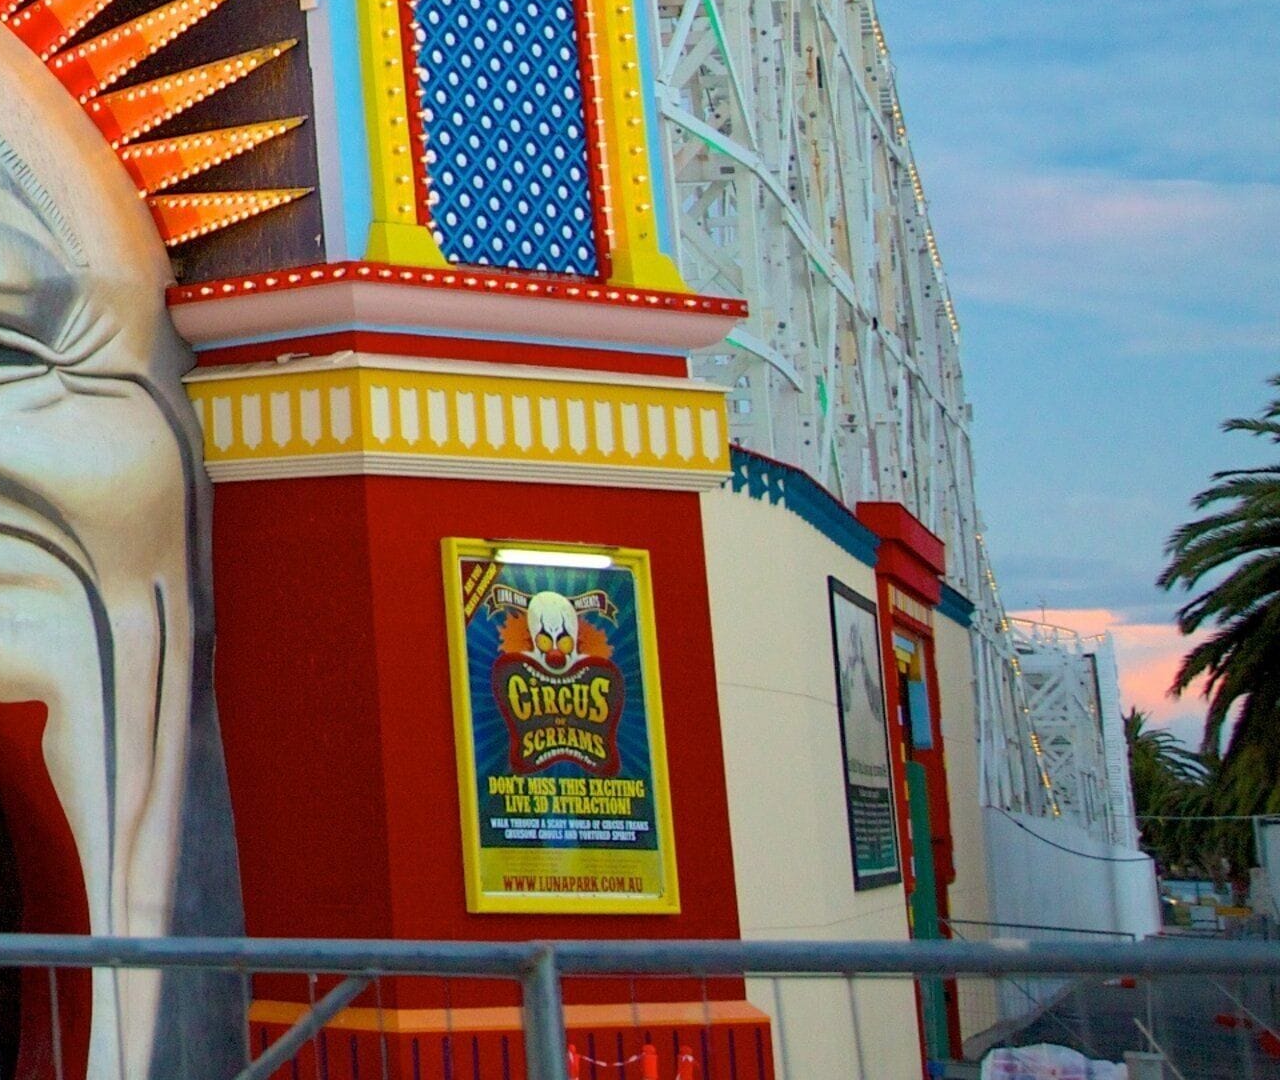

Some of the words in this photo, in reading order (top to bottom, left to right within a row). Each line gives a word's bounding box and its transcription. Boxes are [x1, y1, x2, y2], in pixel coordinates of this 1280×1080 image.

[522, 727, 606, 759] SCREAMS
[489, 776, 525, 795] DON'T
[528, 777, 557, 796] MISS
[559, 778, 586, 796] THIS
[589, 778, 645, 798] EXCITING
[505, 795, 531, 813] LIVE
[533, 796, 548, 814] 3D
[552, 796, 631, 815] ATTRACTION!
[490, 818, 509, 829] WALK
[510, 818, 540, 829] THROUGH
[541, 819, 546, 829] A
[568, 819, 591, 830] WORLD
[601, 820, 624, 830] CIRCUS
[564, 830, 578, 840] AND
